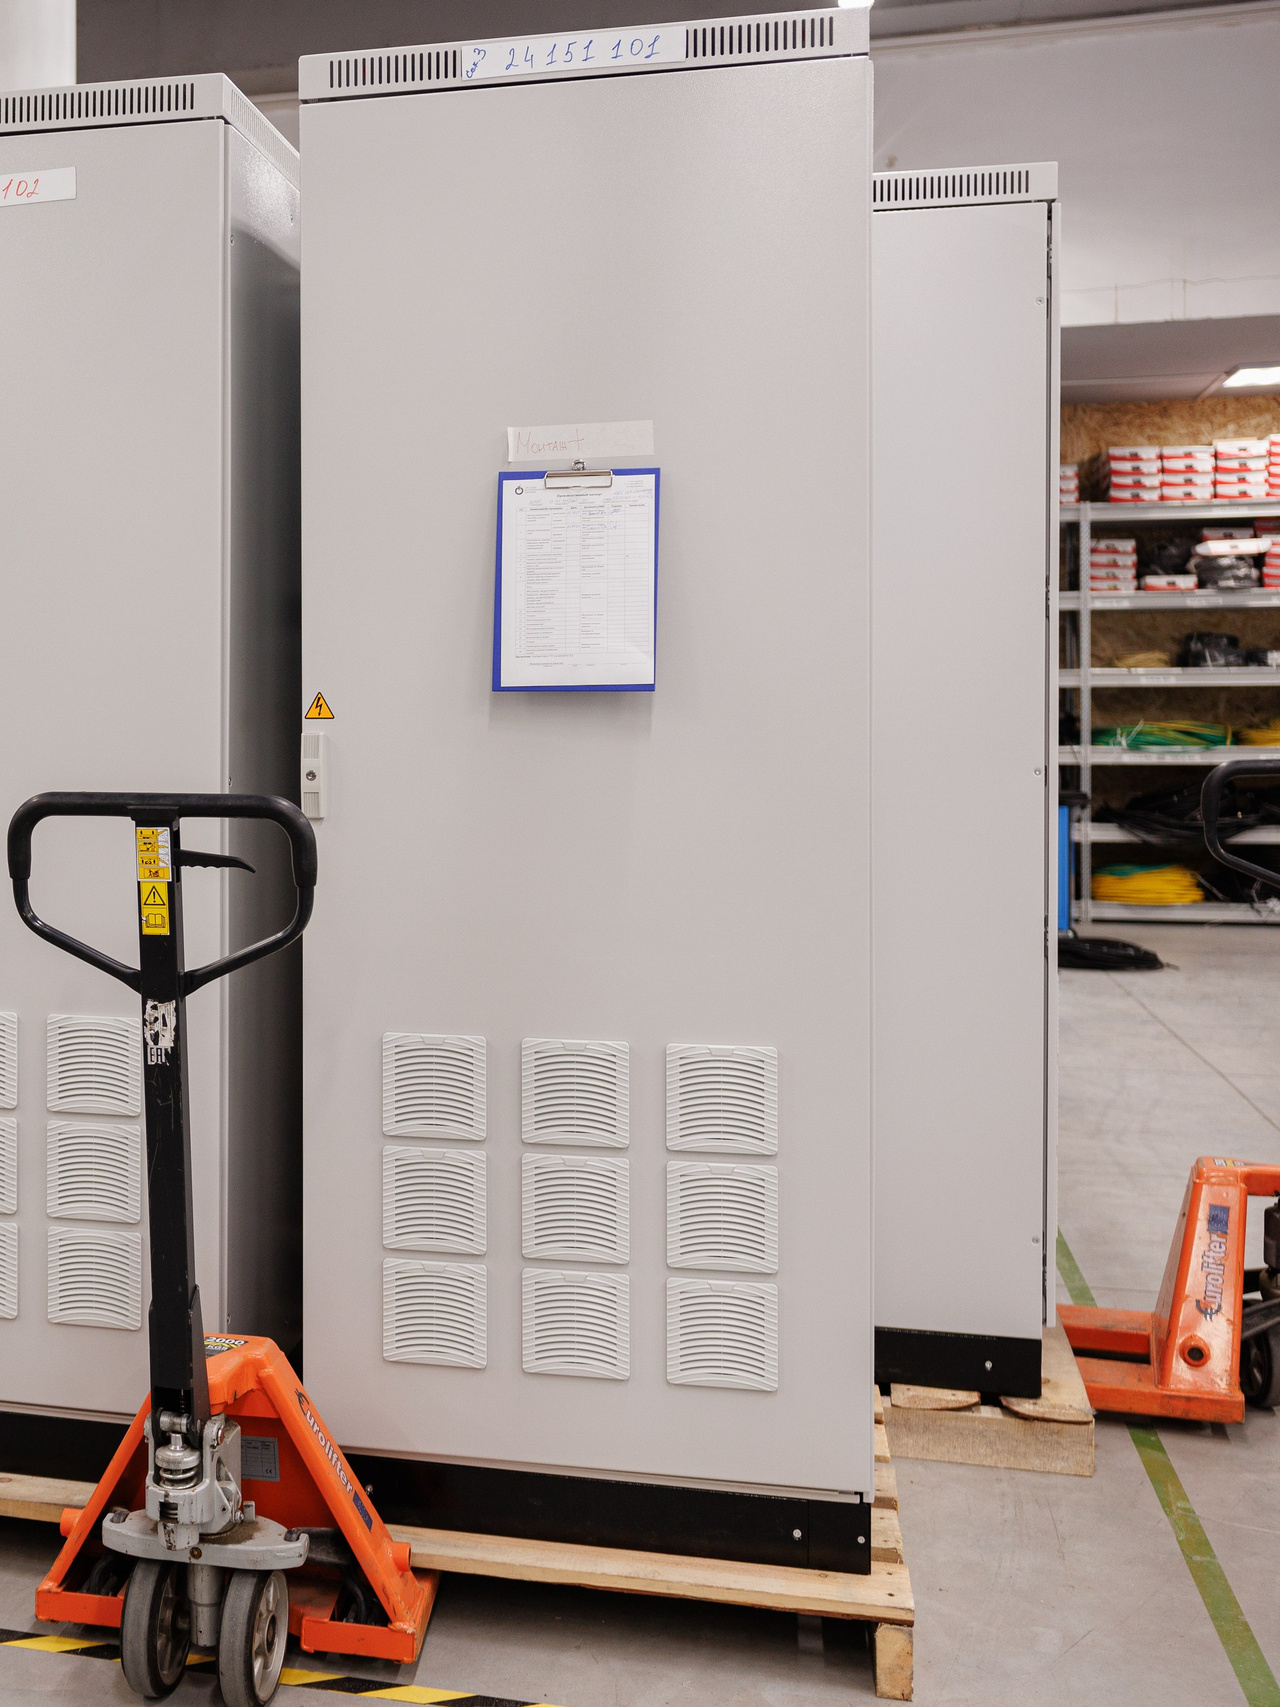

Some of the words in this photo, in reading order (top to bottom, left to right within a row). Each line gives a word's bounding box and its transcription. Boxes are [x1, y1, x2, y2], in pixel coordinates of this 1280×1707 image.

[505, 45, 534, 71] 24
[545, 39, 595, 66] 151
[611, 35, 660, 60] 101
[2, 178, 40, 200] 102
[205, 1336, 245, 1345] 2000
